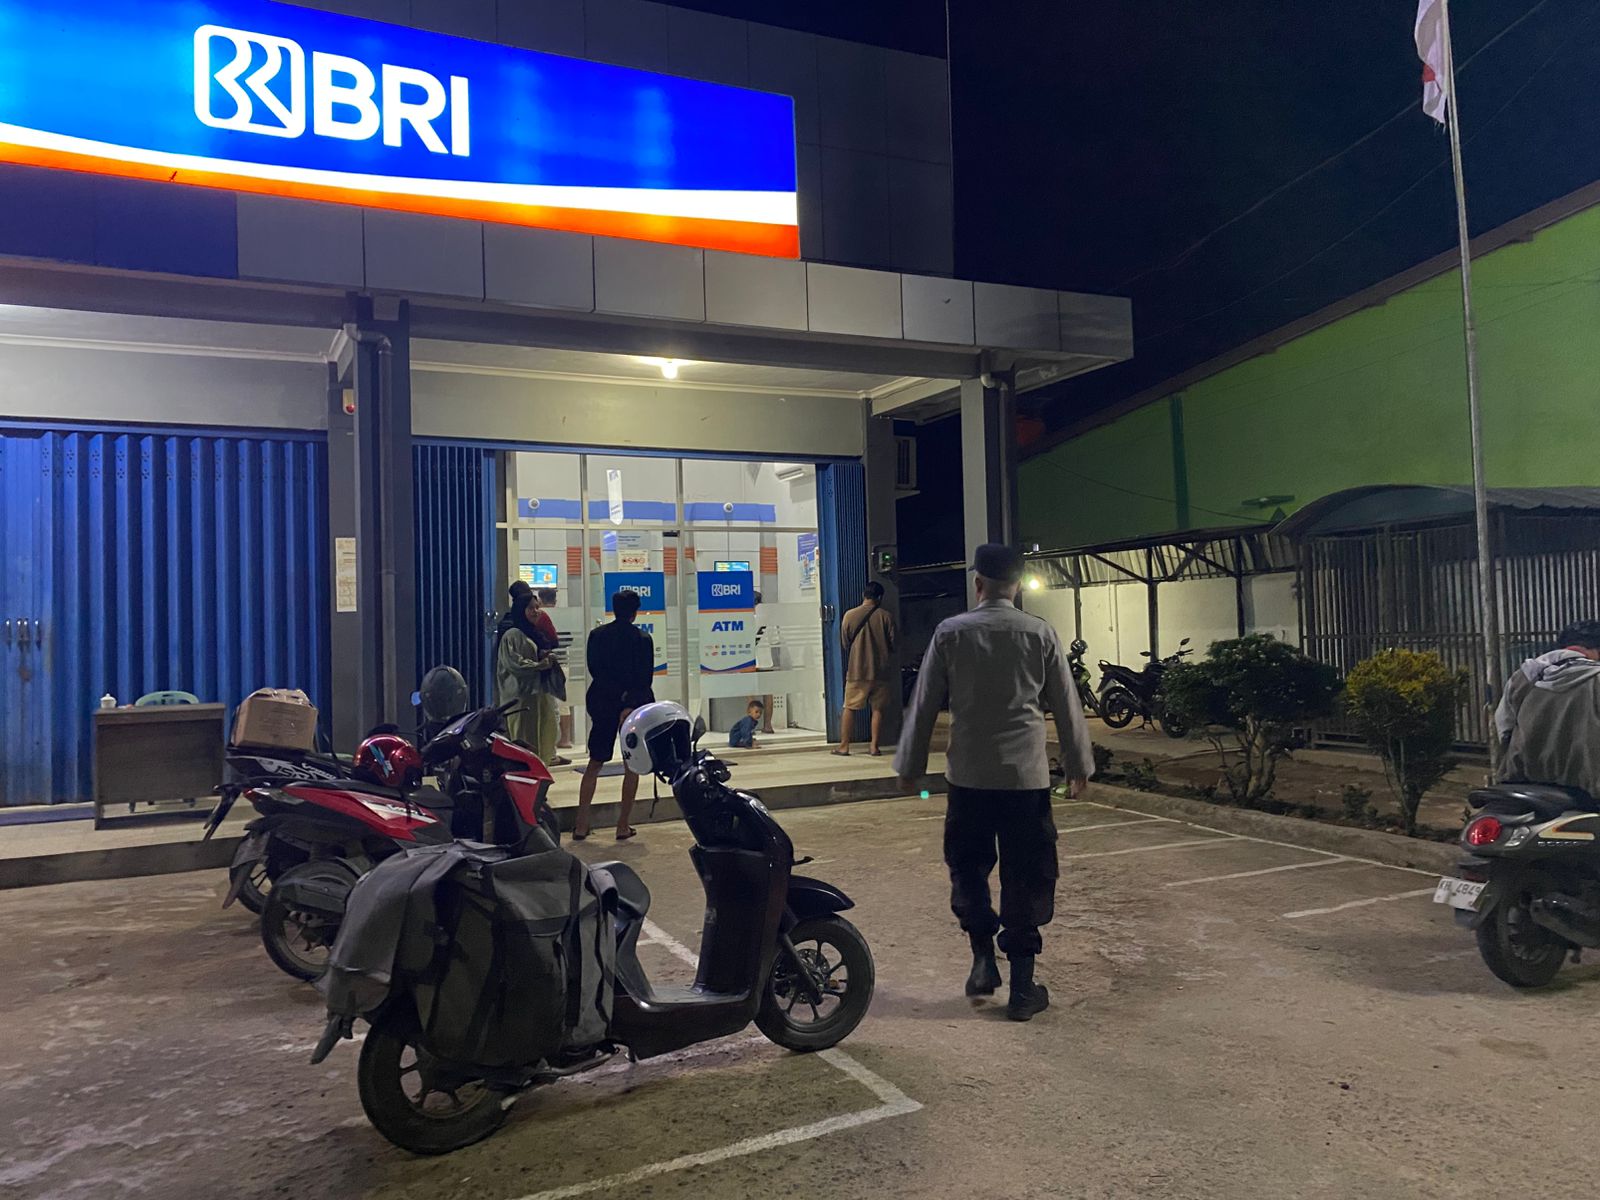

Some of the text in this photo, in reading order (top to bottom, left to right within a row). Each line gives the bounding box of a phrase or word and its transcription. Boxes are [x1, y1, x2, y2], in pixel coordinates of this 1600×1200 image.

[312, 50, 470, 157] BRI
[723, 584, 741, 596] BRI
[711, 620, 744, 632] ATM
